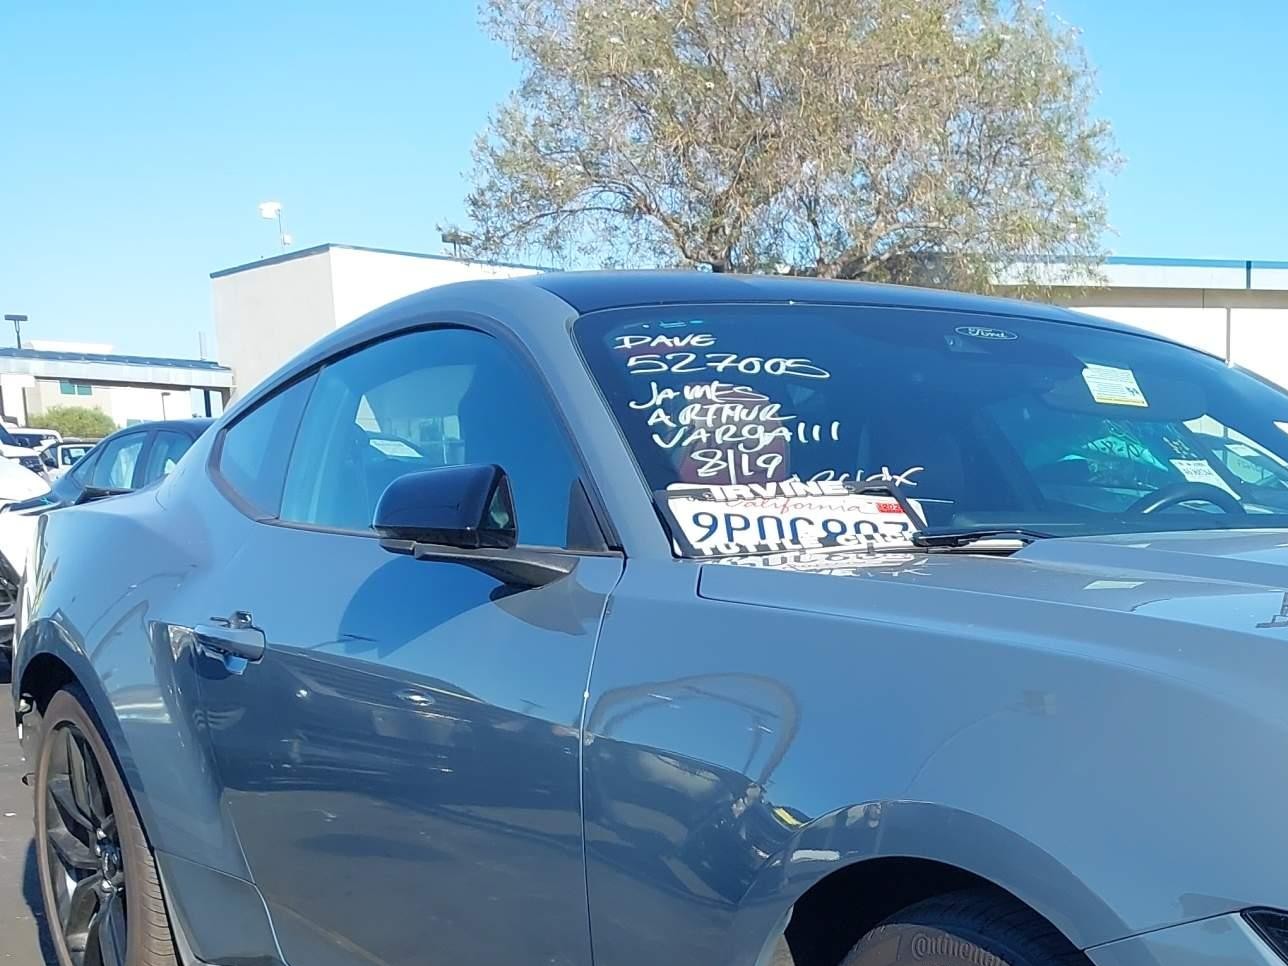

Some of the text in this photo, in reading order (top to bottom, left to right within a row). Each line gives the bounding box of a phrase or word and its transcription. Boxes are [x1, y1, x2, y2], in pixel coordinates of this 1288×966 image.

[613, 334, 718, 349] DAVE
[629, 380, 770, 409] JAMES
[647, 403, 798, 428] ARTHUR
[690, 449, 784, 486] 8/19
[709, 481, 850, 502] IRVINE
[690, 531, 824, 556] TUTTLE
